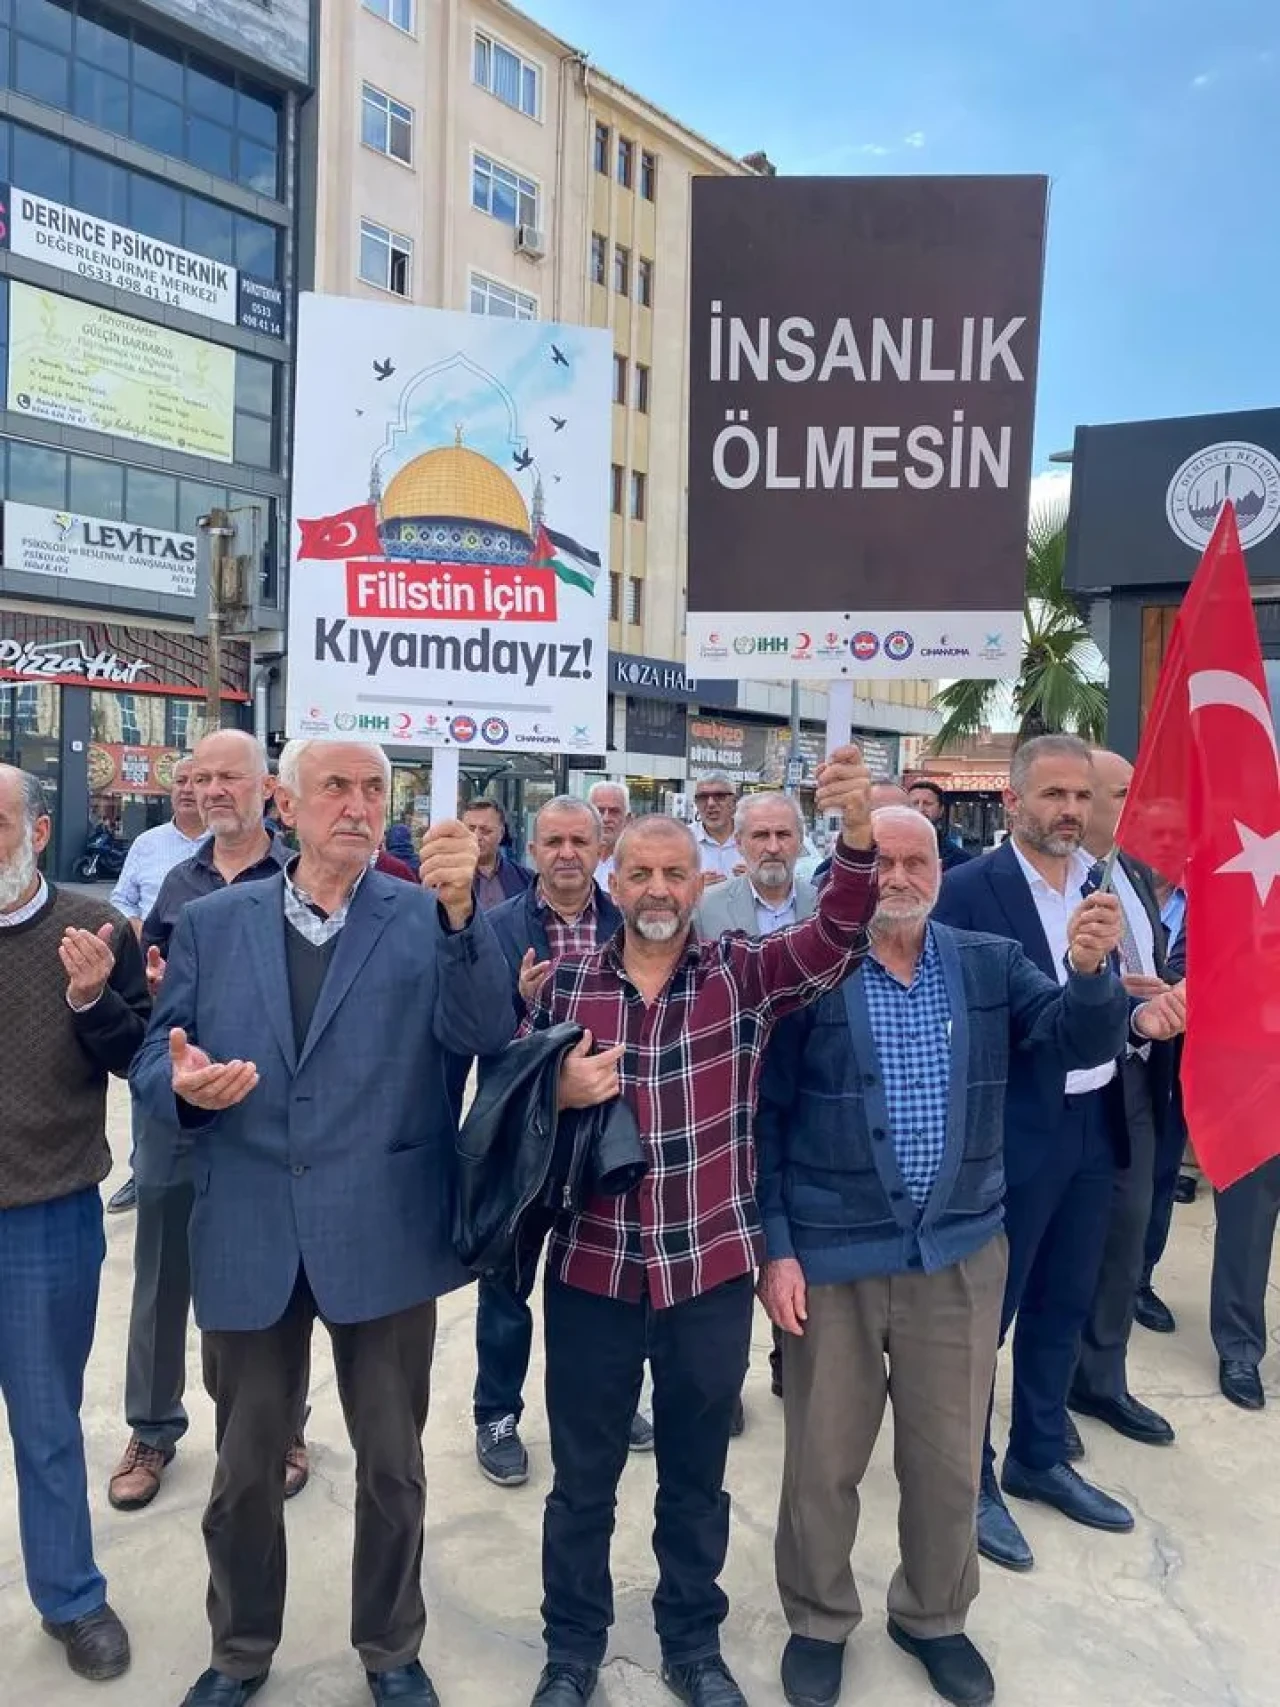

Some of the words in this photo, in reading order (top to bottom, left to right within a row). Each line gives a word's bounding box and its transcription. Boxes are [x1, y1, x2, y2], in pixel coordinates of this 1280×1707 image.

[22, 198, 105, 248] DERİNCE
[112, 230, 228, 291] PSİKOTEKNİK
[36, 230, 157, 282] DEĞERLENDİRME
[162, 275, 217, 304] MERKEZİ
[78, 262, 112, 282] 0533
[117, 276, 141, 292] 498
[145, 284, 159, 299] 41
[165, 291, 179, 305] 14
[710, 299, 1026, 383] İNSANLIK
[712, 409, 1011, 489] ÖLMESİN
[83, 522, 195, 561] LEVİTAS
[357, 570, 474, 613] Filistin
[484, 569, 545, 619] İçin
[86, 650, 151, 684] Hut
[314, 617, 592, 687] Kıyamdayız!
[616, 660, 659, 687] KOZA
